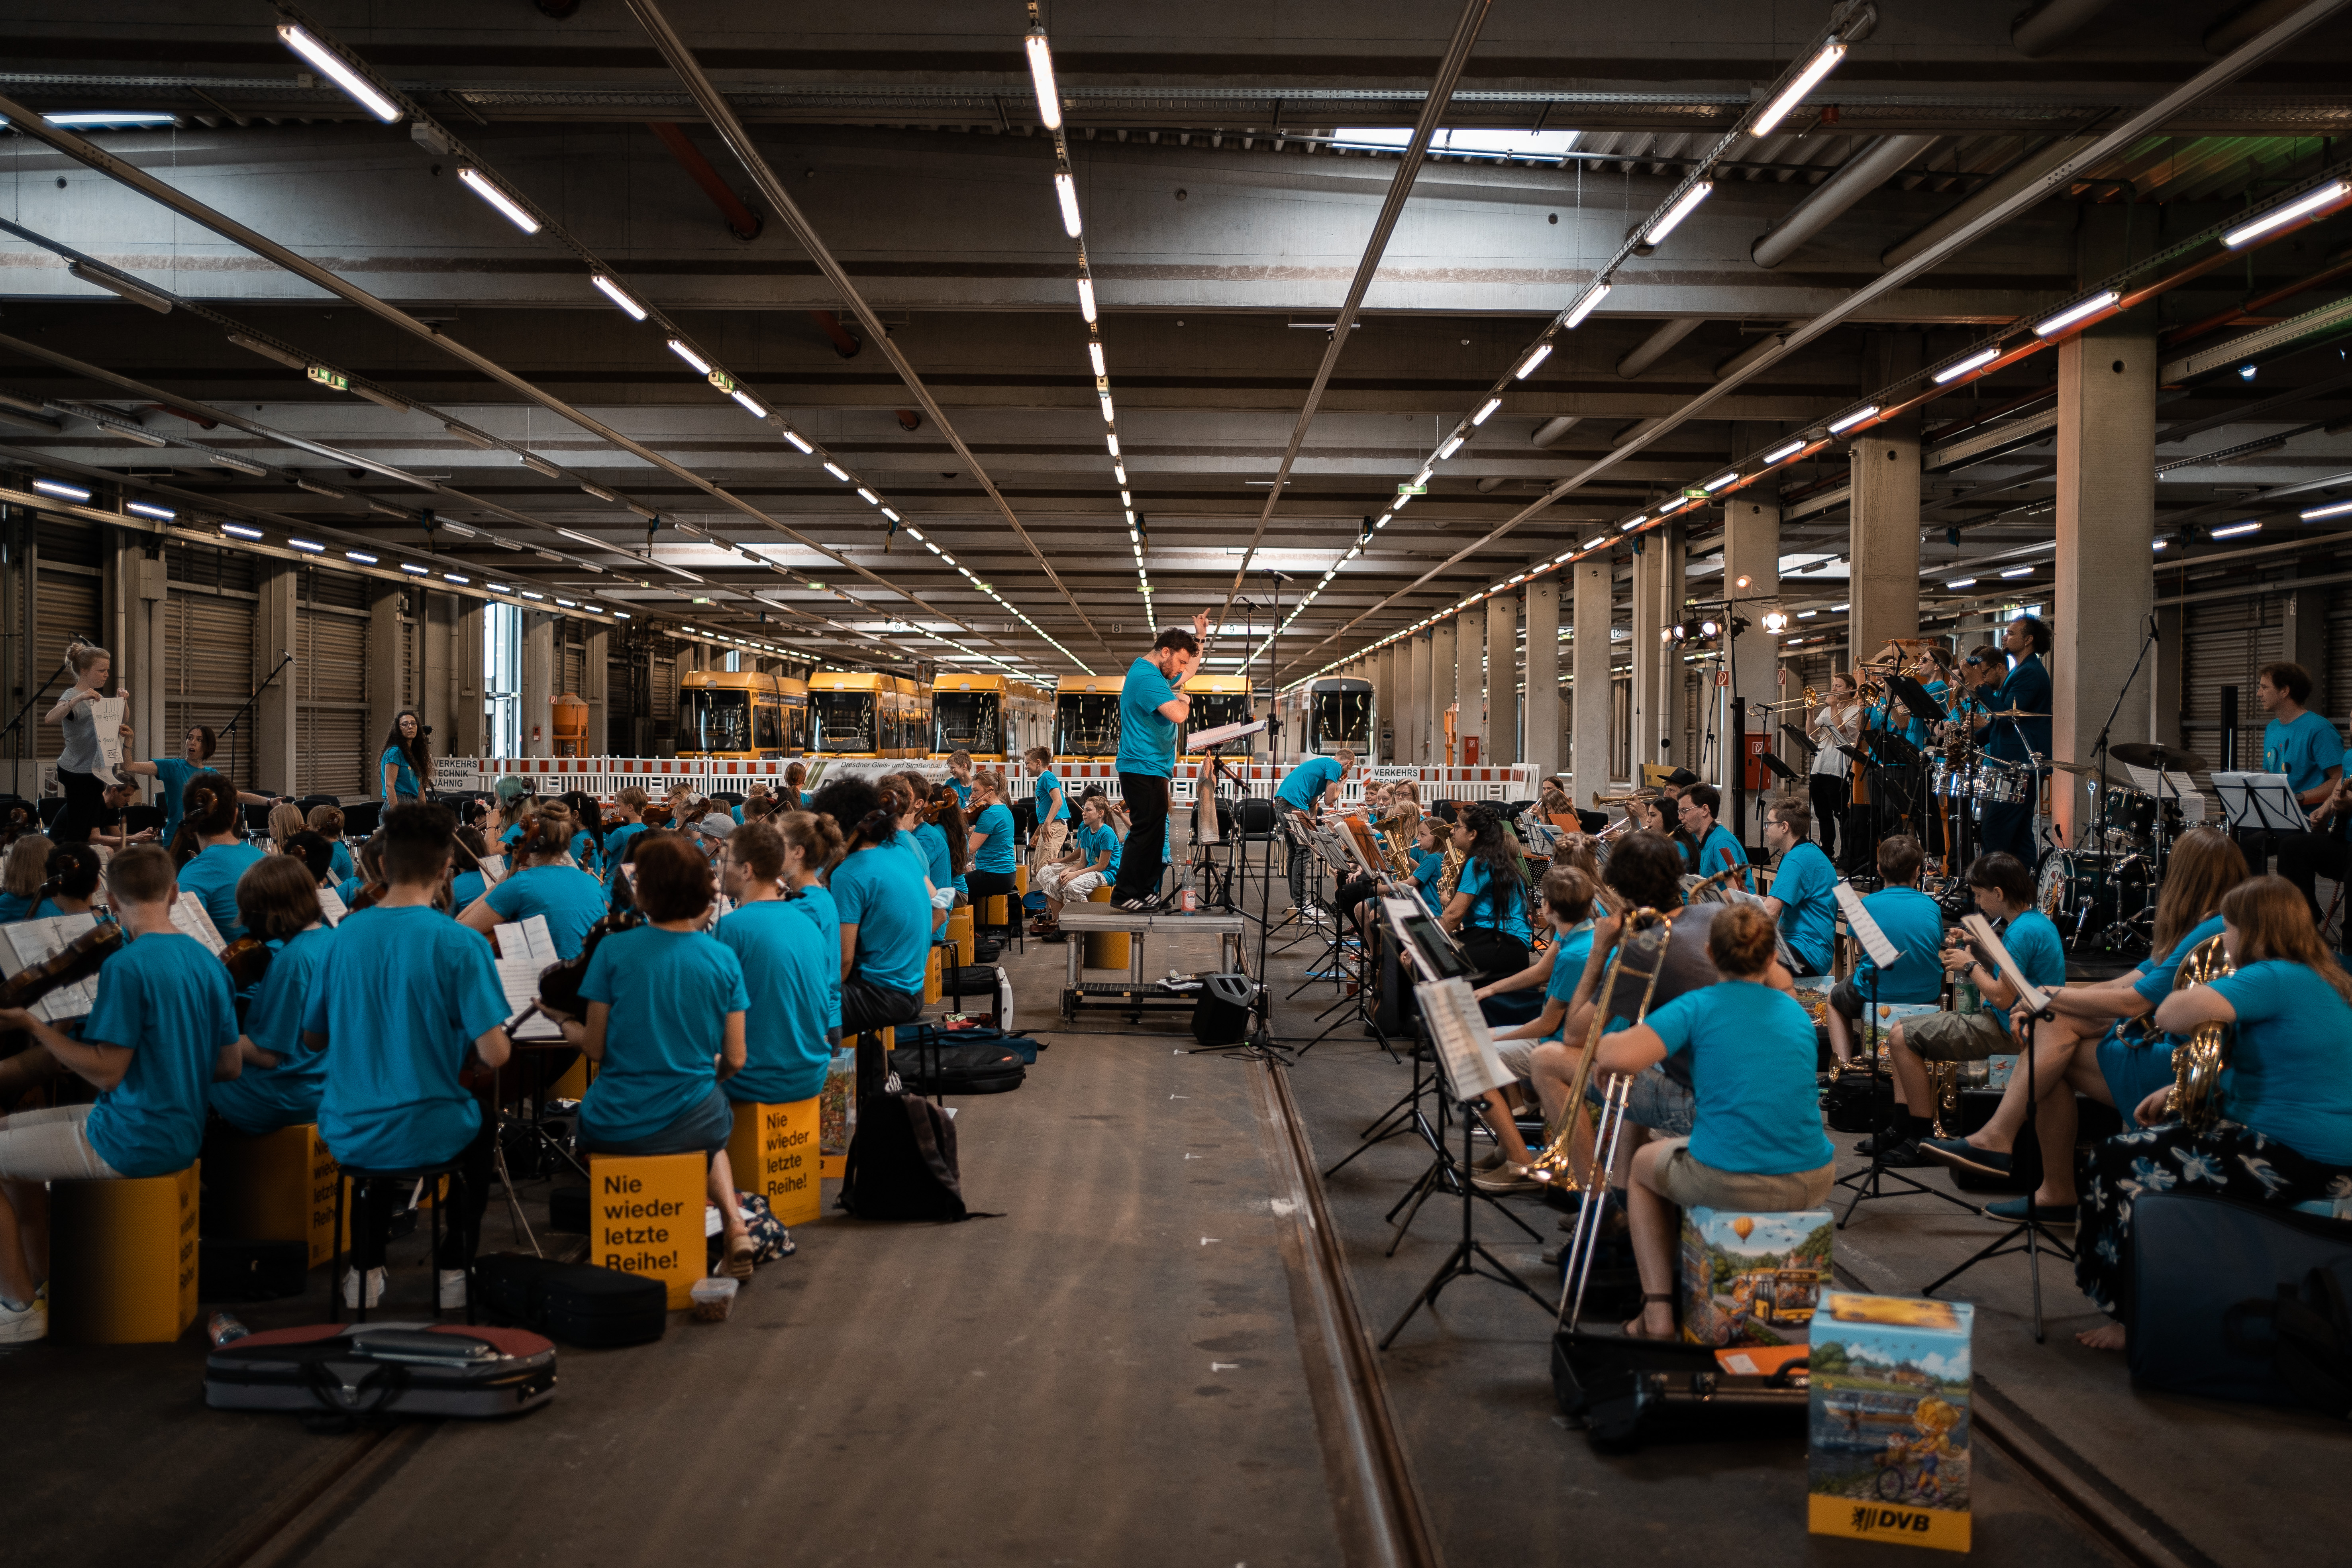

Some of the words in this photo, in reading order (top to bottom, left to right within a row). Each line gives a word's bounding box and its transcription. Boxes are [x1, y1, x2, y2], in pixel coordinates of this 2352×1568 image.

[1229, 624, 1234, 633] 9
[1612, 629, 1621, 638] 12
[434, 759, 477, 768] VERKEHRS
[434, 778, 463, 787] JÄHNIG
[767, 1112, 788, 1130] Nie
[767, 1130, 810, 1151] wieder
[767, 1154, 802, 1174] letzte
[604, 1176, 642, 1194] Nie
[767, 1172, 807, 1195] Reihe!
[603, 1198, 684, 1219] wieder
[605, 1226, 669, 1245] letzte
[605, 1250, 678, 1271] Reihe!
[1878, 1509, 1930, 1532] DVB
